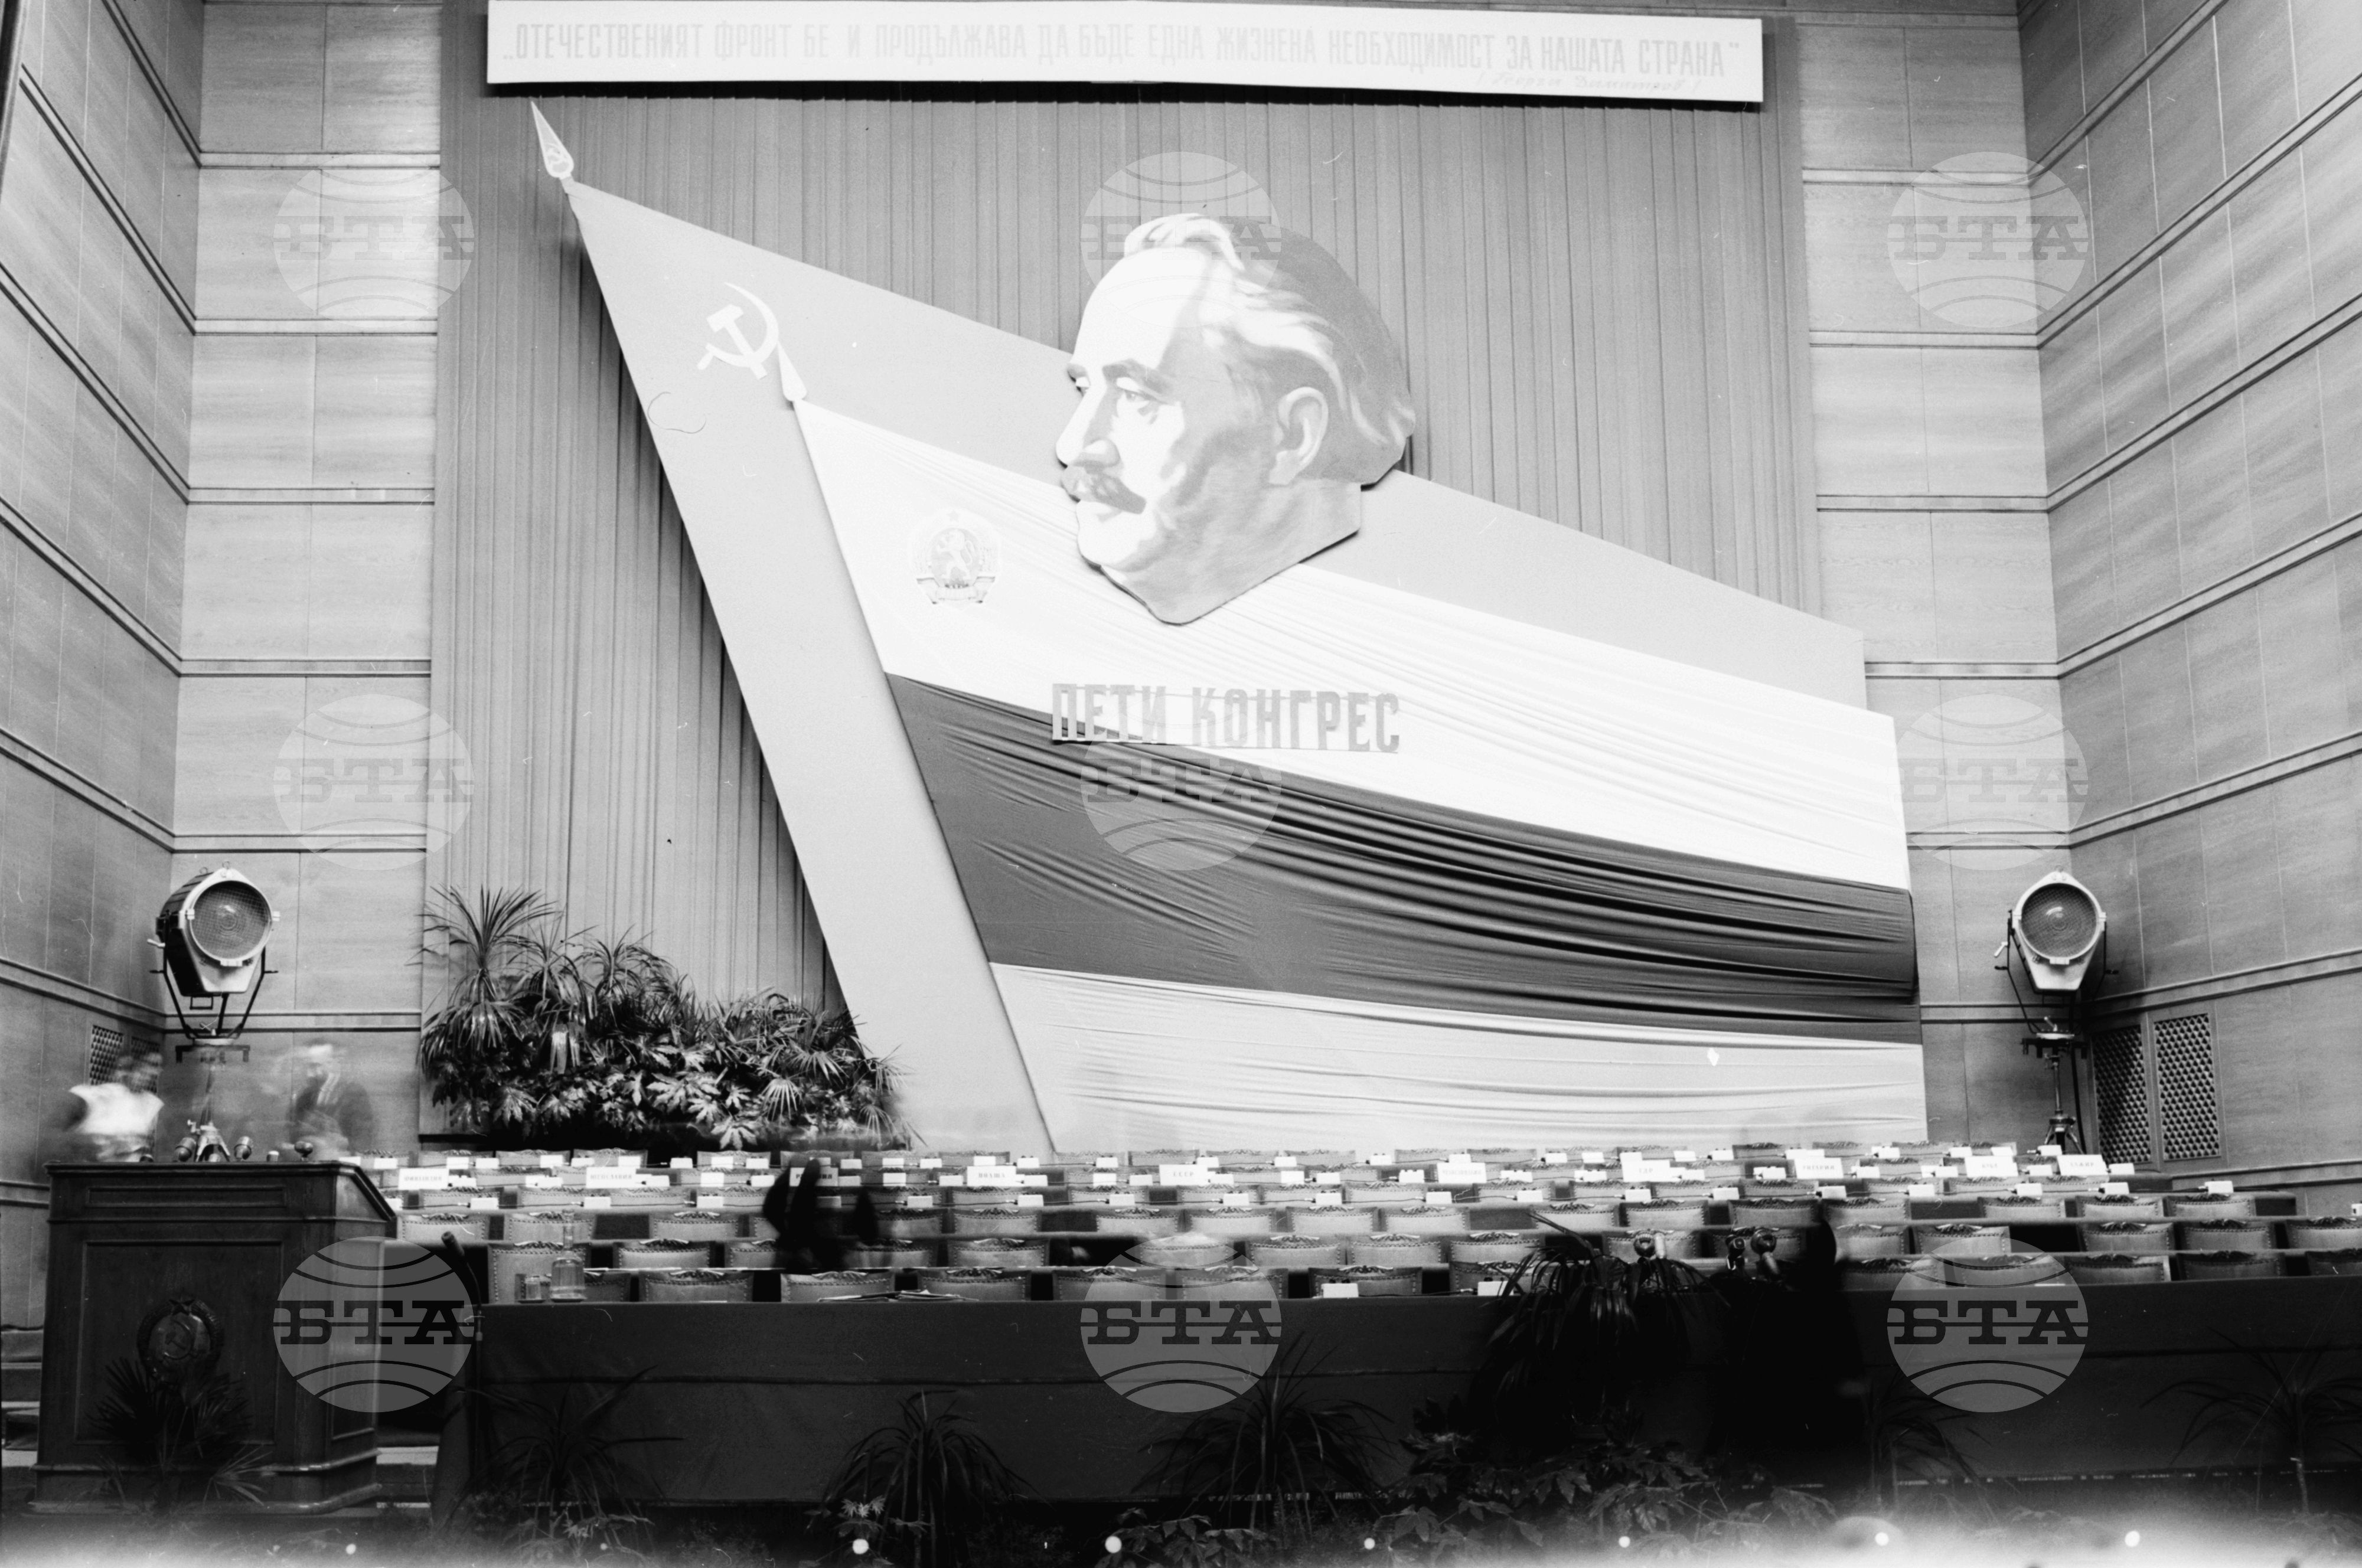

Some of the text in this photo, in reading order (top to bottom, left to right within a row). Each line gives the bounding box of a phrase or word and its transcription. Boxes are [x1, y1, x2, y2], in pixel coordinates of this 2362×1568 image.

[715, 19, 792, 61] ФРОНТ
[804, 23, 830, 58] БЕ
[847, 24, 861, 58] И
[875, 24, 1027, 66] ПРОДЪЛЖАВА
[1038, 24, 1069, 66] ДА
[1078, 24, 1134, 64] БЪДЕ
[1148, 24, 1205, 66] ЕДНА
[1216, 26, 1317, 64] ЖИЗНЕНА
[1329, 29, 1495, 74] НЕОБХОДИМОСТ
[1506, 35, 1533, 70] ЗА
[1541, 36, 1626, 74] НАШАТА
[1052, 683, 1400, 753] ПЕТИ КОНГРЕС
